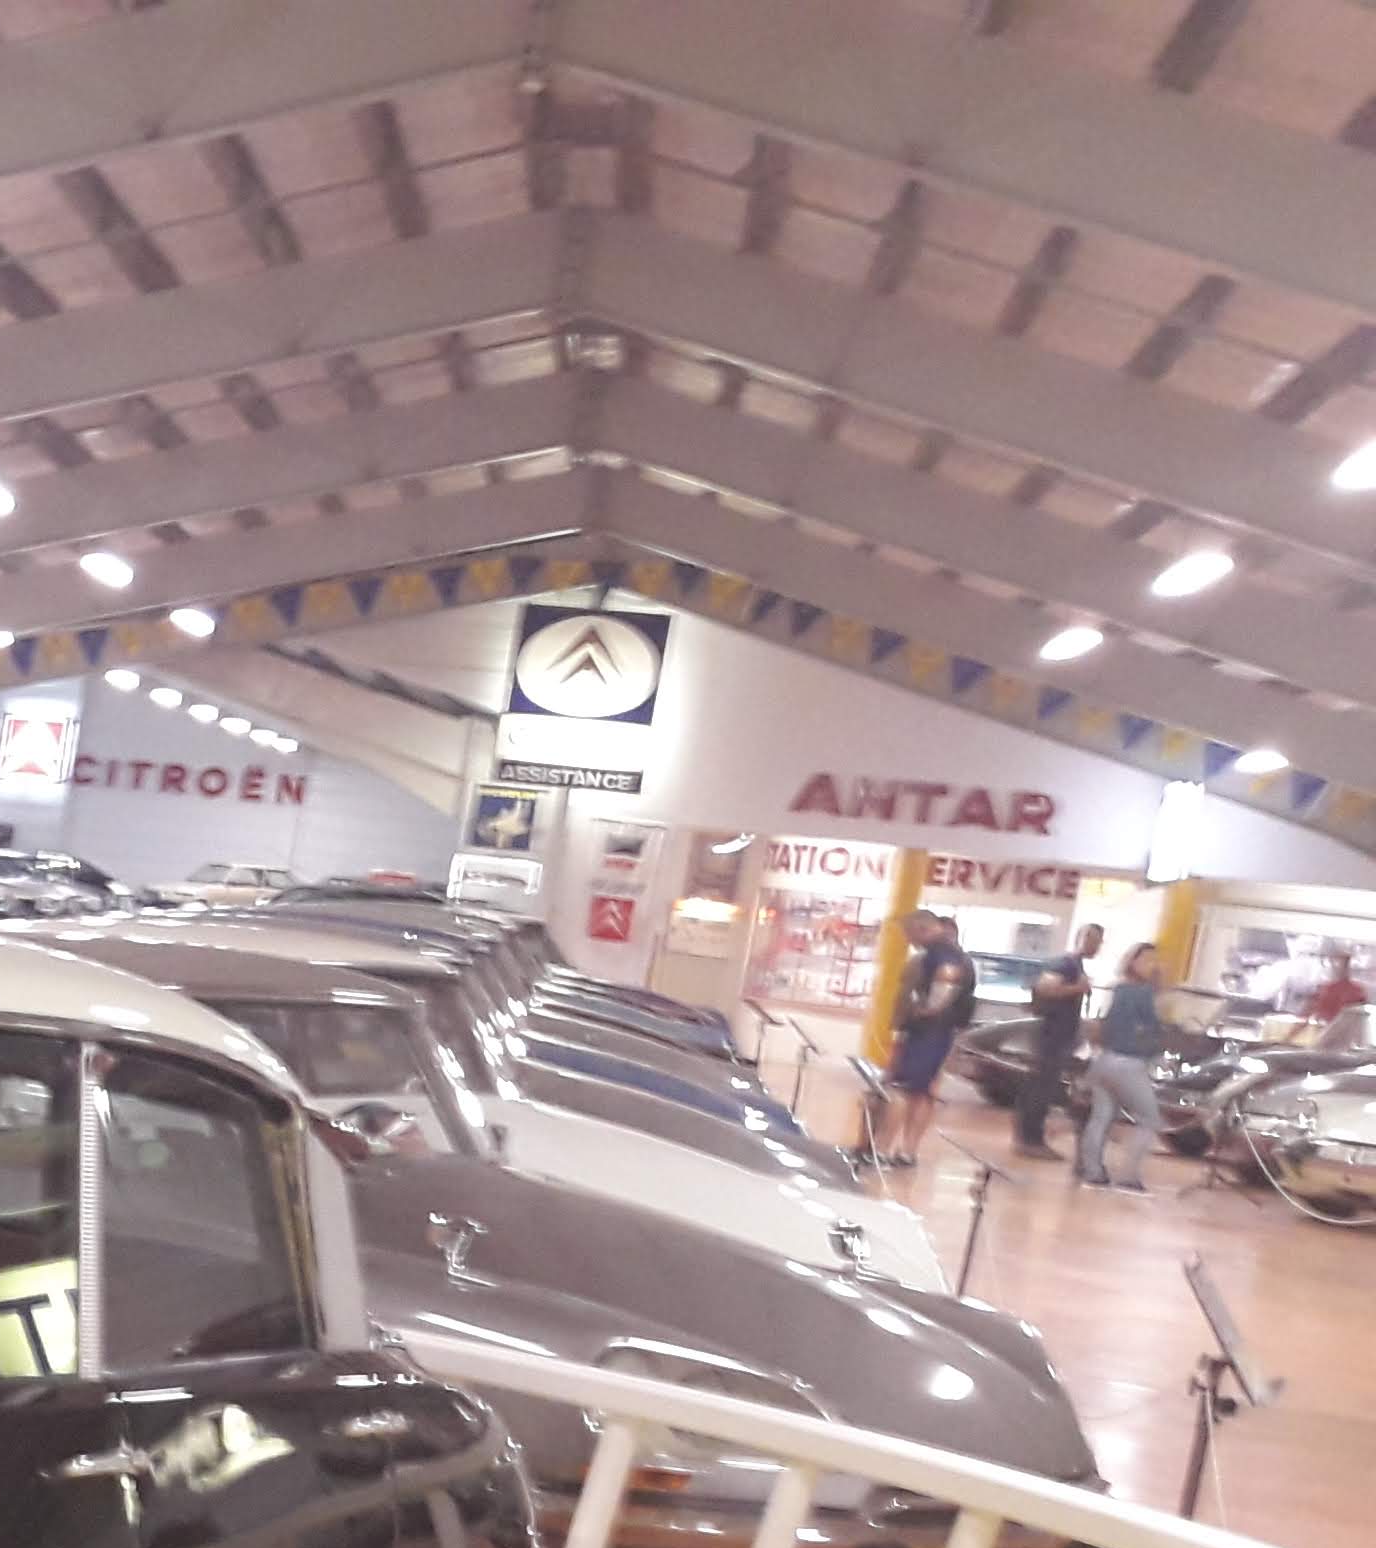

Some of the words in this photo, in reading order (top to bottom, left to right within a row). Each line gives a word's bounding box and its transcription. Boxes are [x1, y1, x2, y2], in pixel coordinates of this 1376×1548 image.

[73, 756, 307, 804] CITROËN
[501, 764, 634, 790] ASSISTANCE
[789, 772, 1056, 835] ANTAR
[763, 843, 885, 880] TATION
[927, 855, 1081, 900] ERVICE
